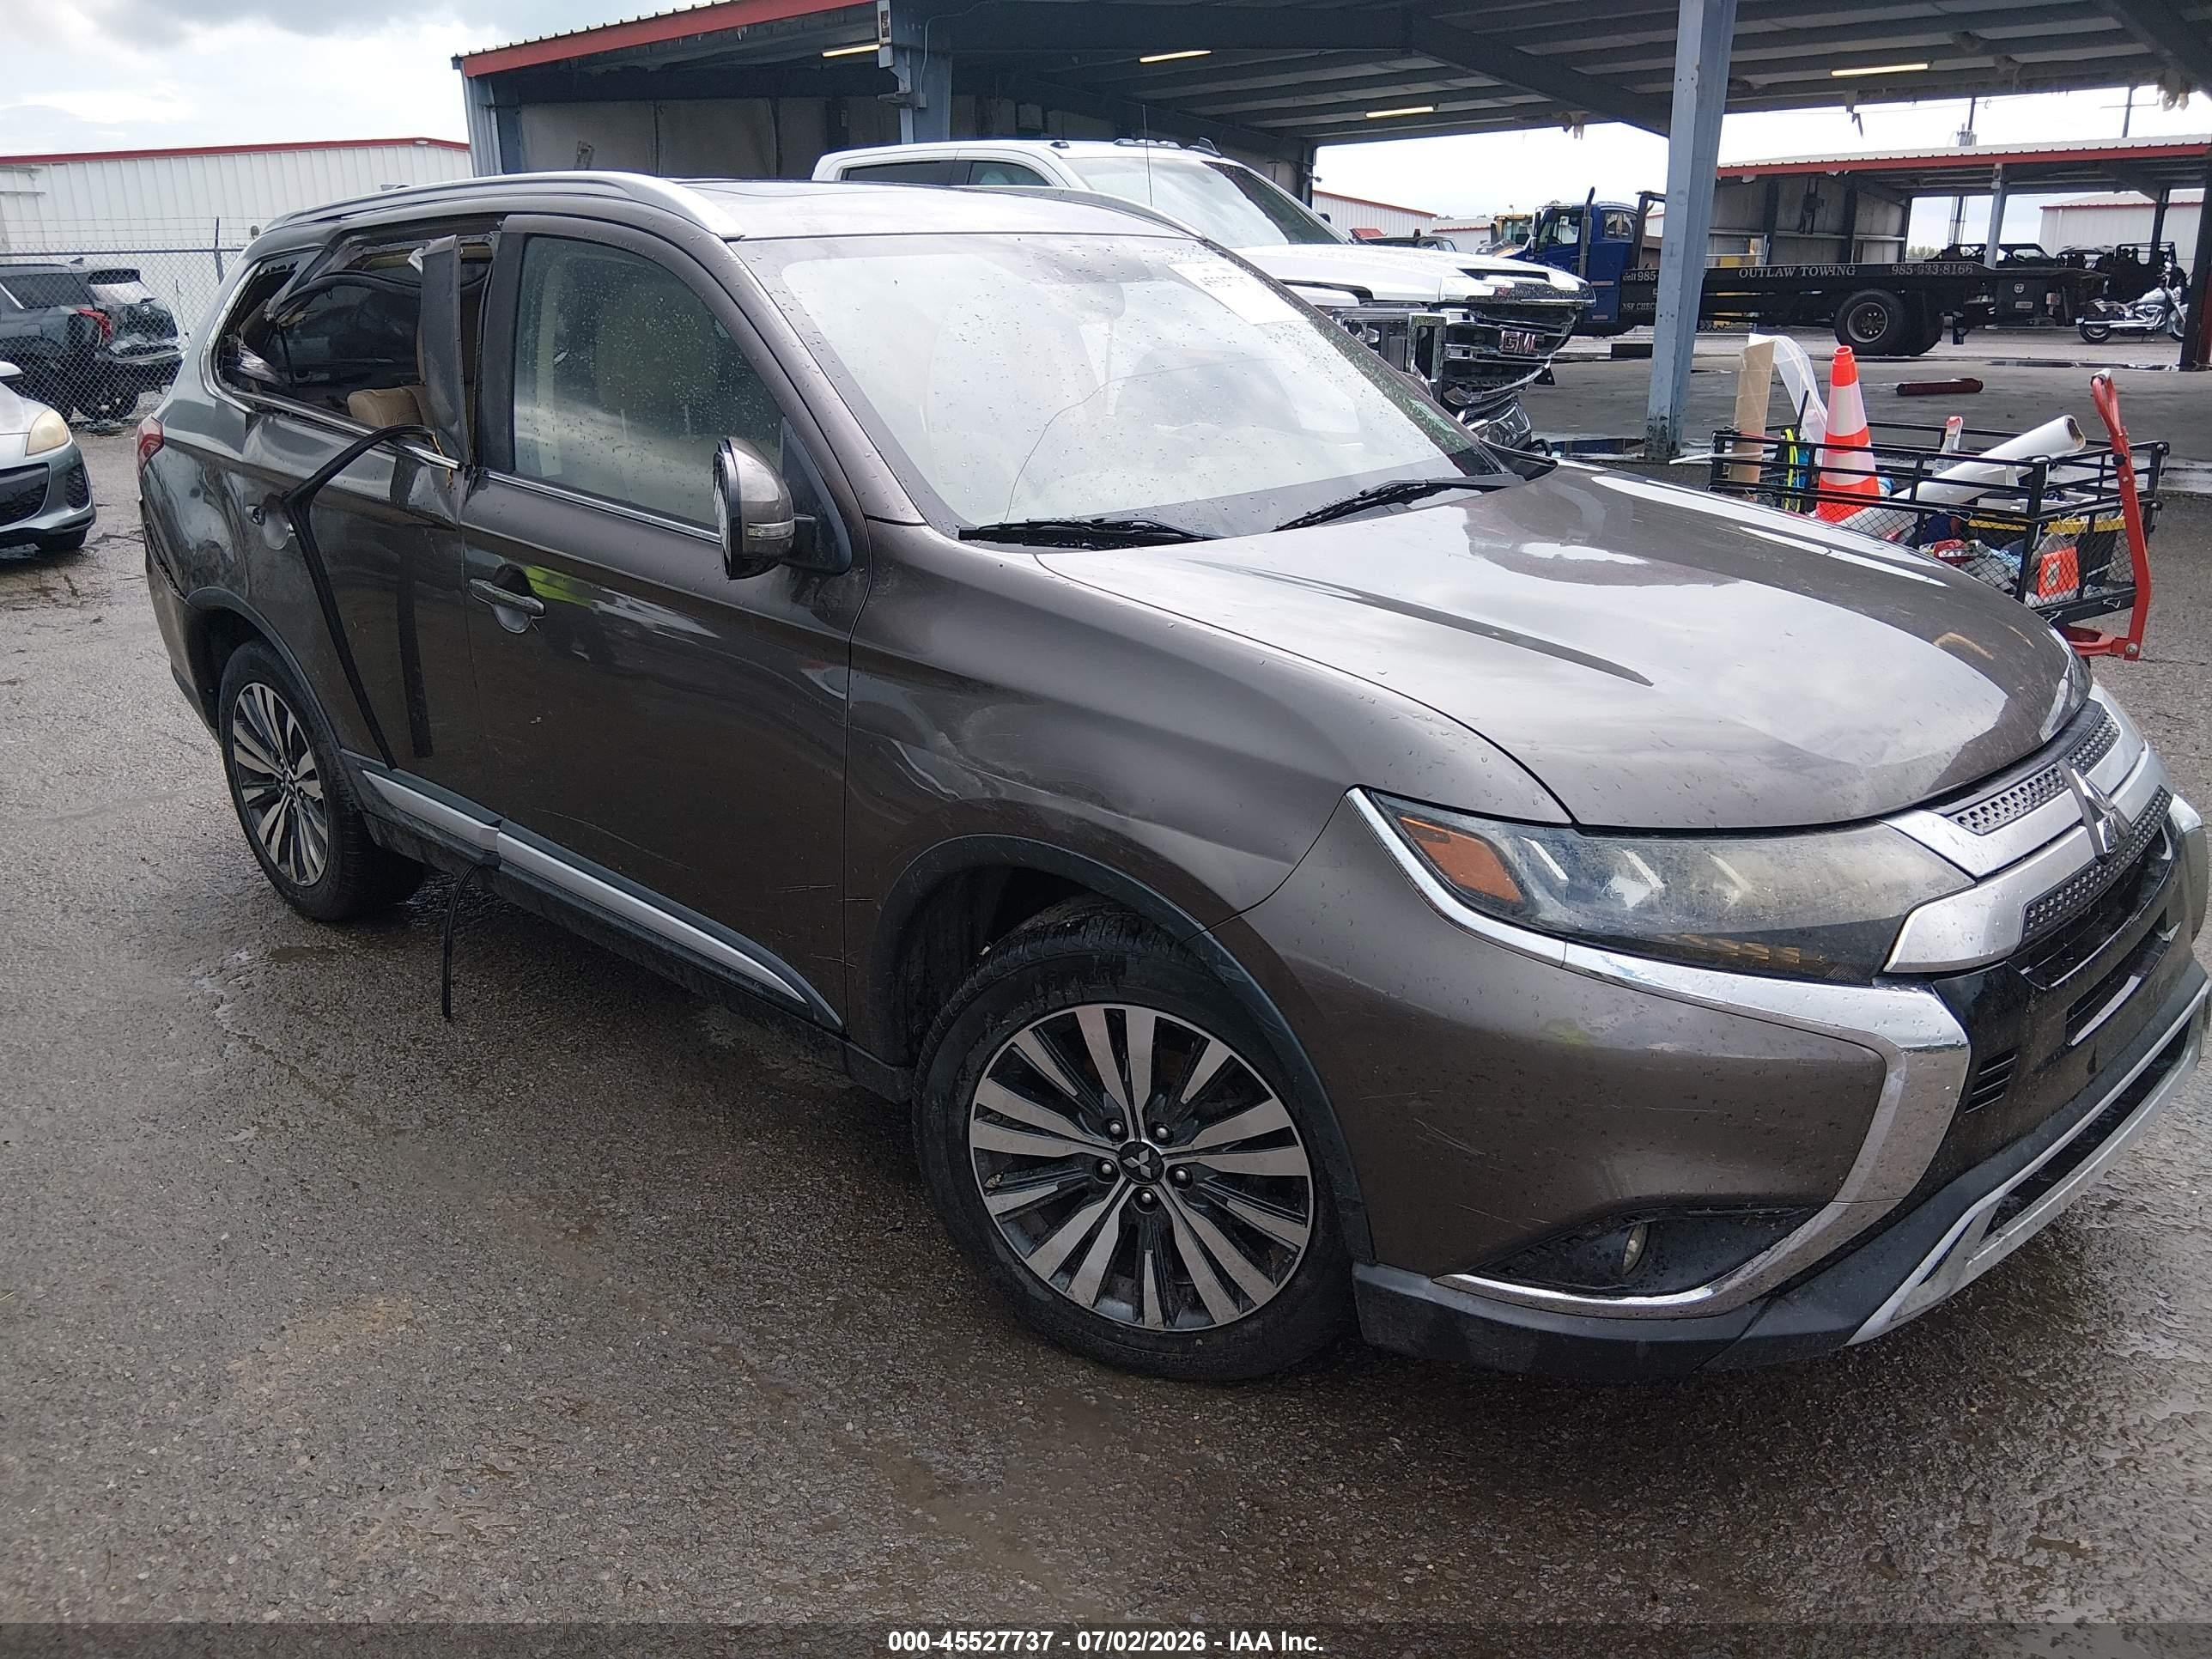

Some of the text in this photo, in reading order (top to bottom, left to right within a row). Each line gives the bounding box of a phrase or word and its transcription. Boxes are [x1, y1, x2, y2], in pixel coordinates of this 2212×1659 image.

[1739, 265, 1856, 278] OUTLAW TOWING
[1501, 330, 1544, 355] GMC
